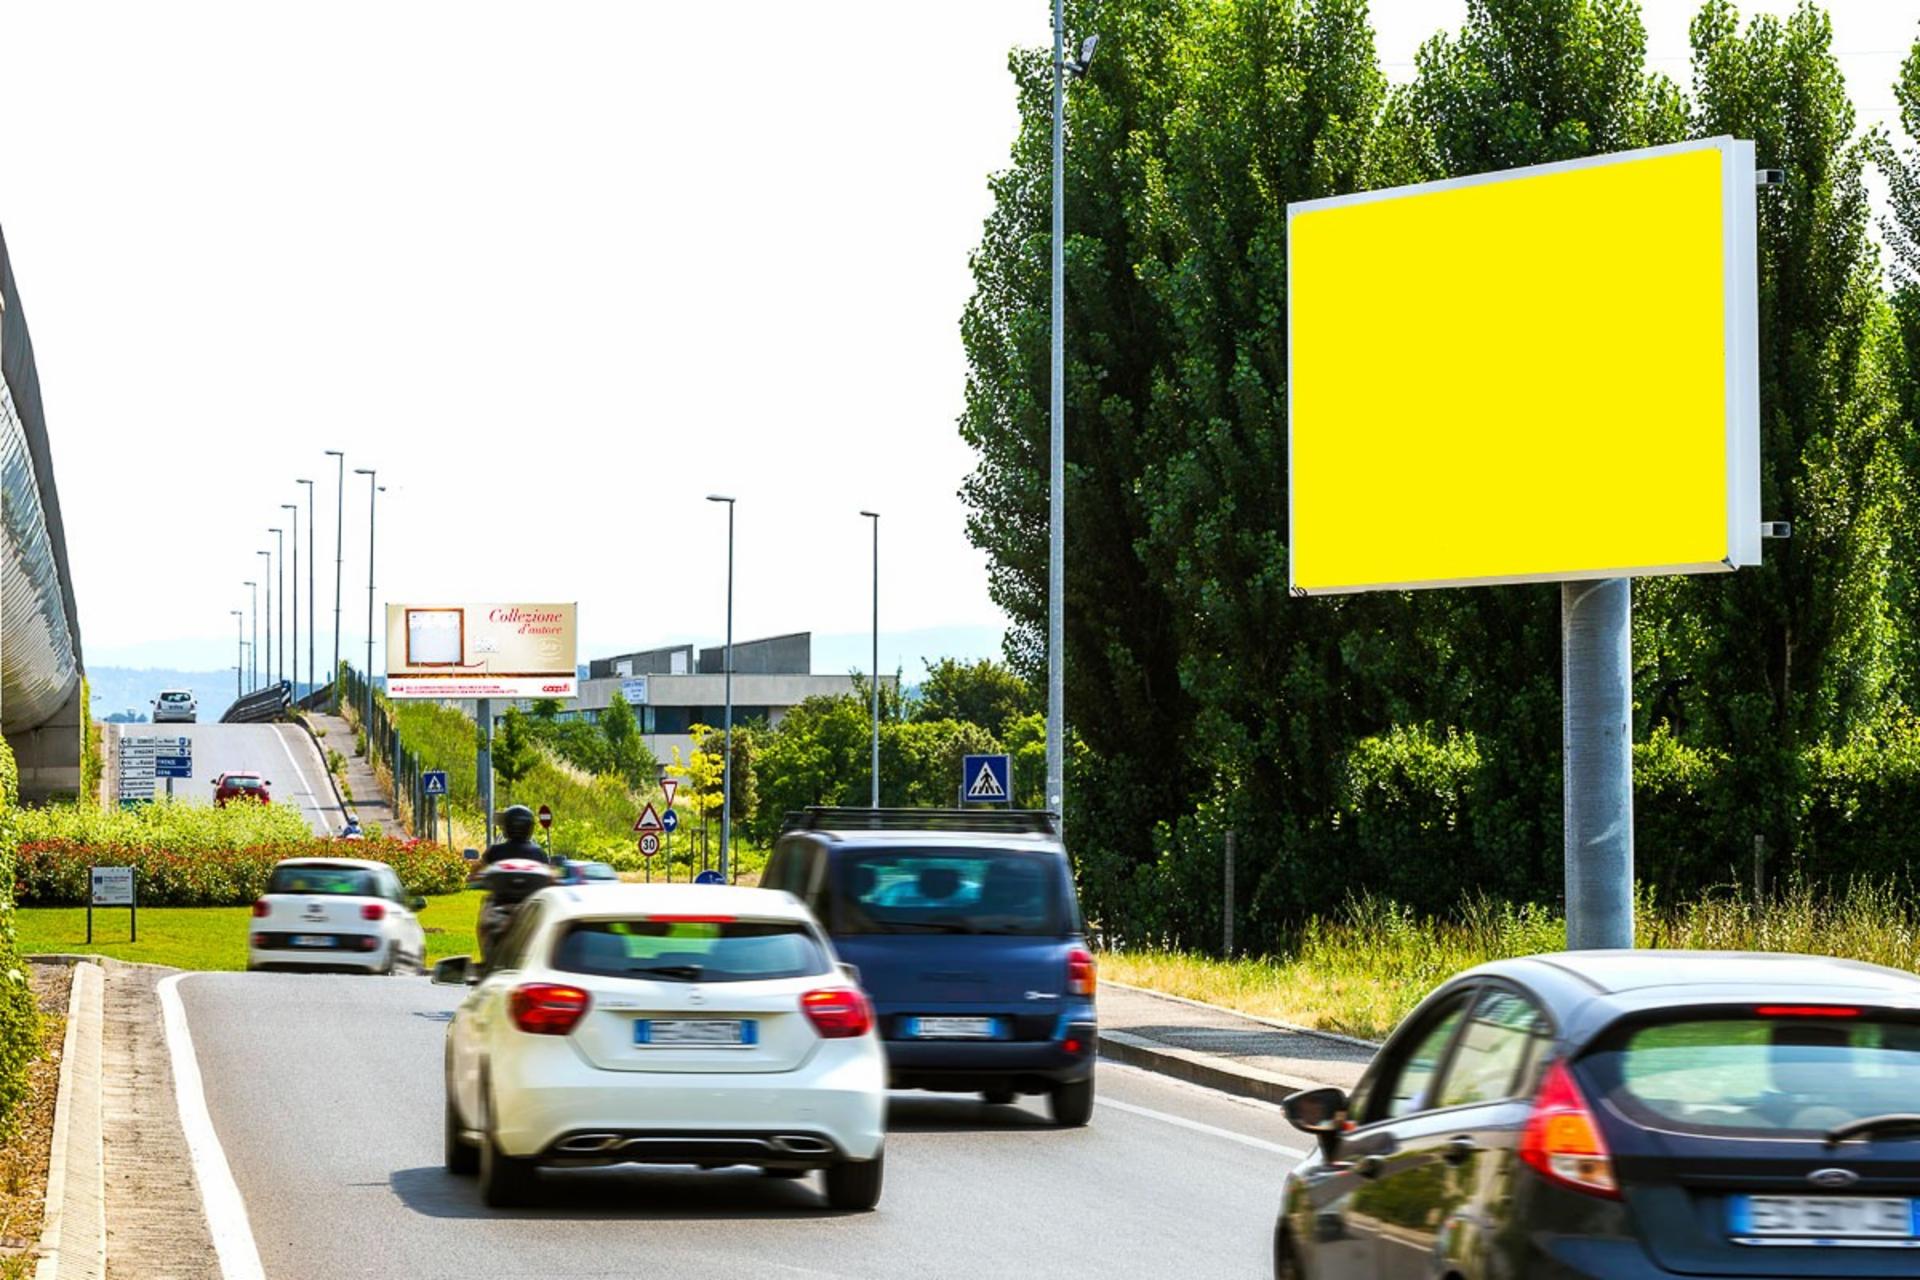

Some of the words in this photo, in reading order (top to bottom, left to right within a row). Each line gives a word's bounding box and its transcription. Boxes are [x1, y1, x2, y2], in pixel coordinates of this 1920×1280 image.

[488, 608, 563, 623] Collezione
[517, 623, 563, 635] d'autore
[643, 838, 655, 851] 30
